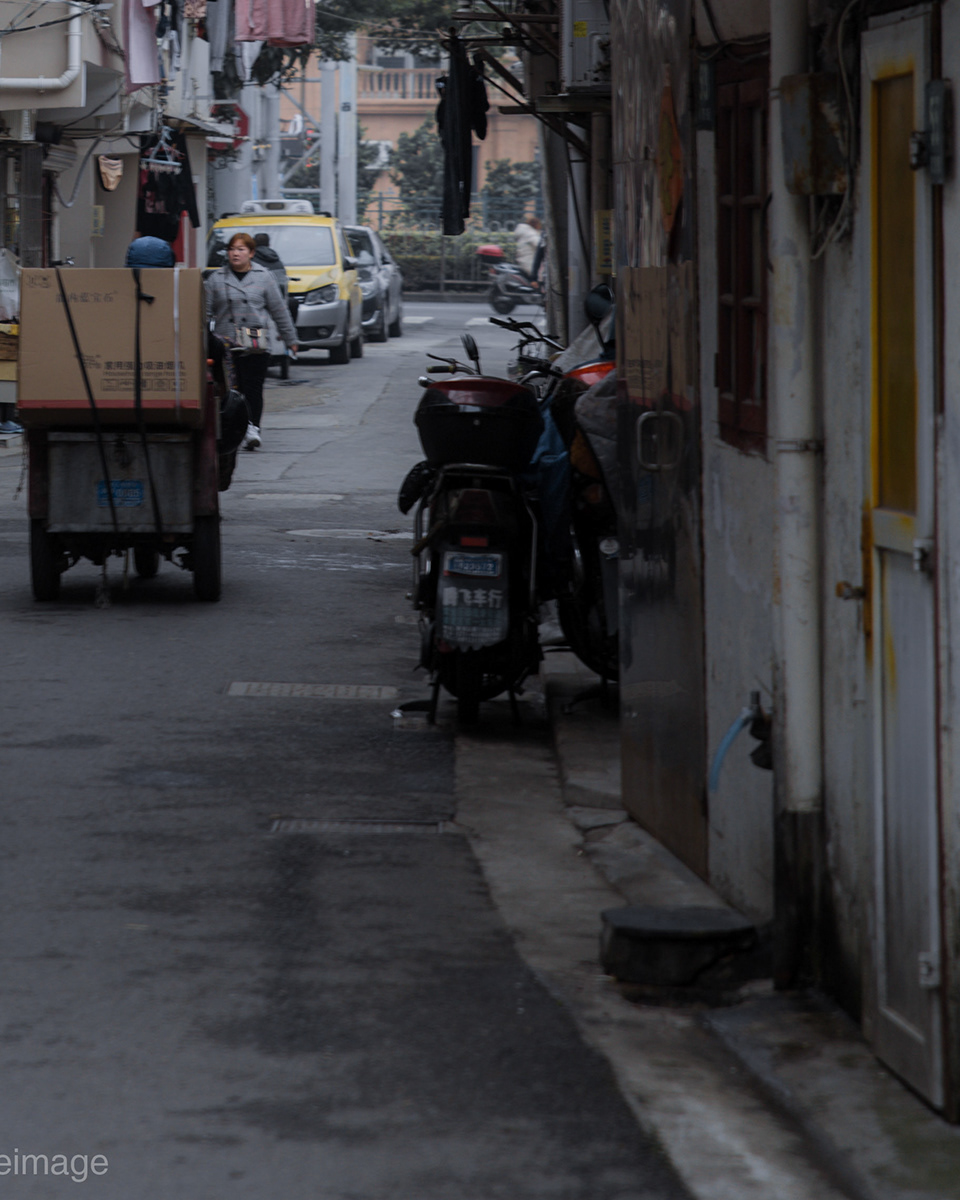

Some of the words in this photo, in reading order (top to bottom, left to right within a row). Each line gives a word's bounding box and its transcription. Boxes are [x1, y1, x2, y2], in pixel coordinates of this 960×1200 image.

[104, 361, 186, 370] 家用强吸油烟机
